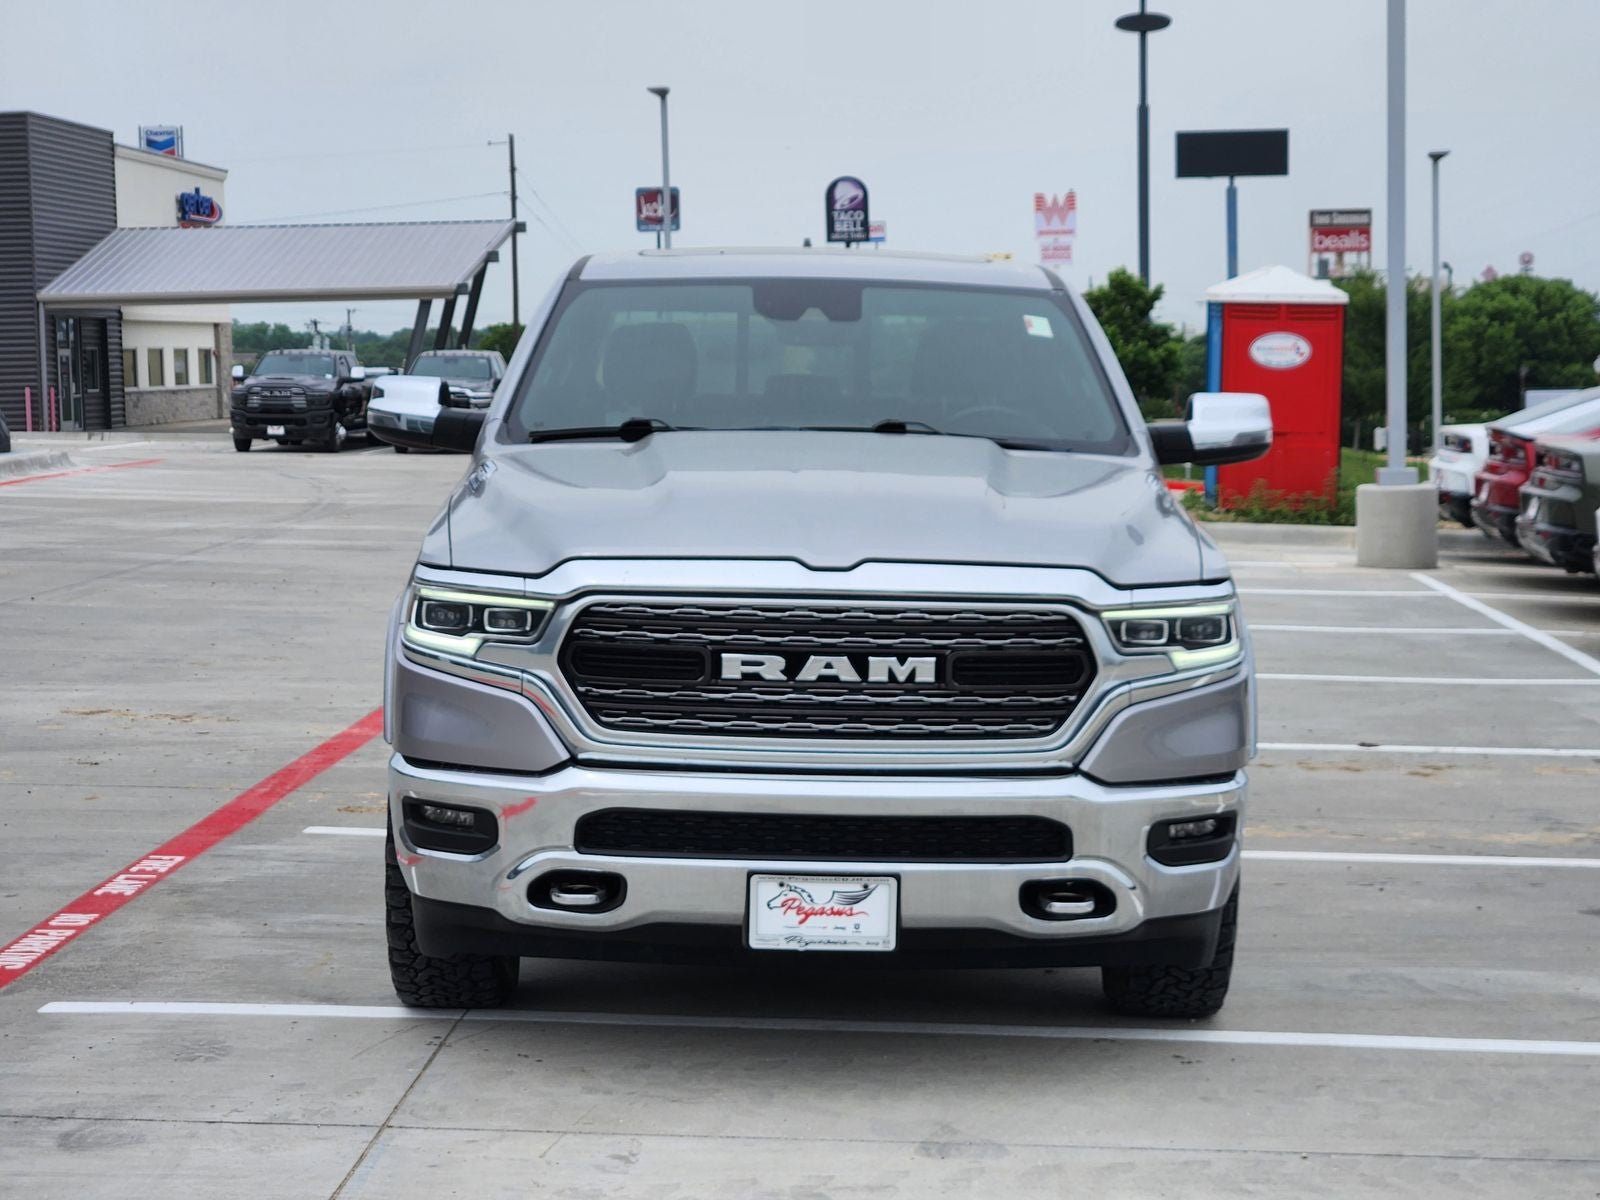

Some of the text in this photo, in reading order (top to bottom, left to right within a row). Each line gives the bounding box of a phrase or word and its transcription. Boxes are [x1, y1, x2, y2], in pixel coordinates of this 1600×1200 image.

[831, 210, 865, 220] TACO
[834, 220, 865, 232] BELL
[1312, 229, 1369, 250] bealls
[720, 653, 936, 683] RAM
[93, 874, 157, 896] LANE
[48, 913, 100, 926] NO
[781, 898, 869, 926] Pegasus
